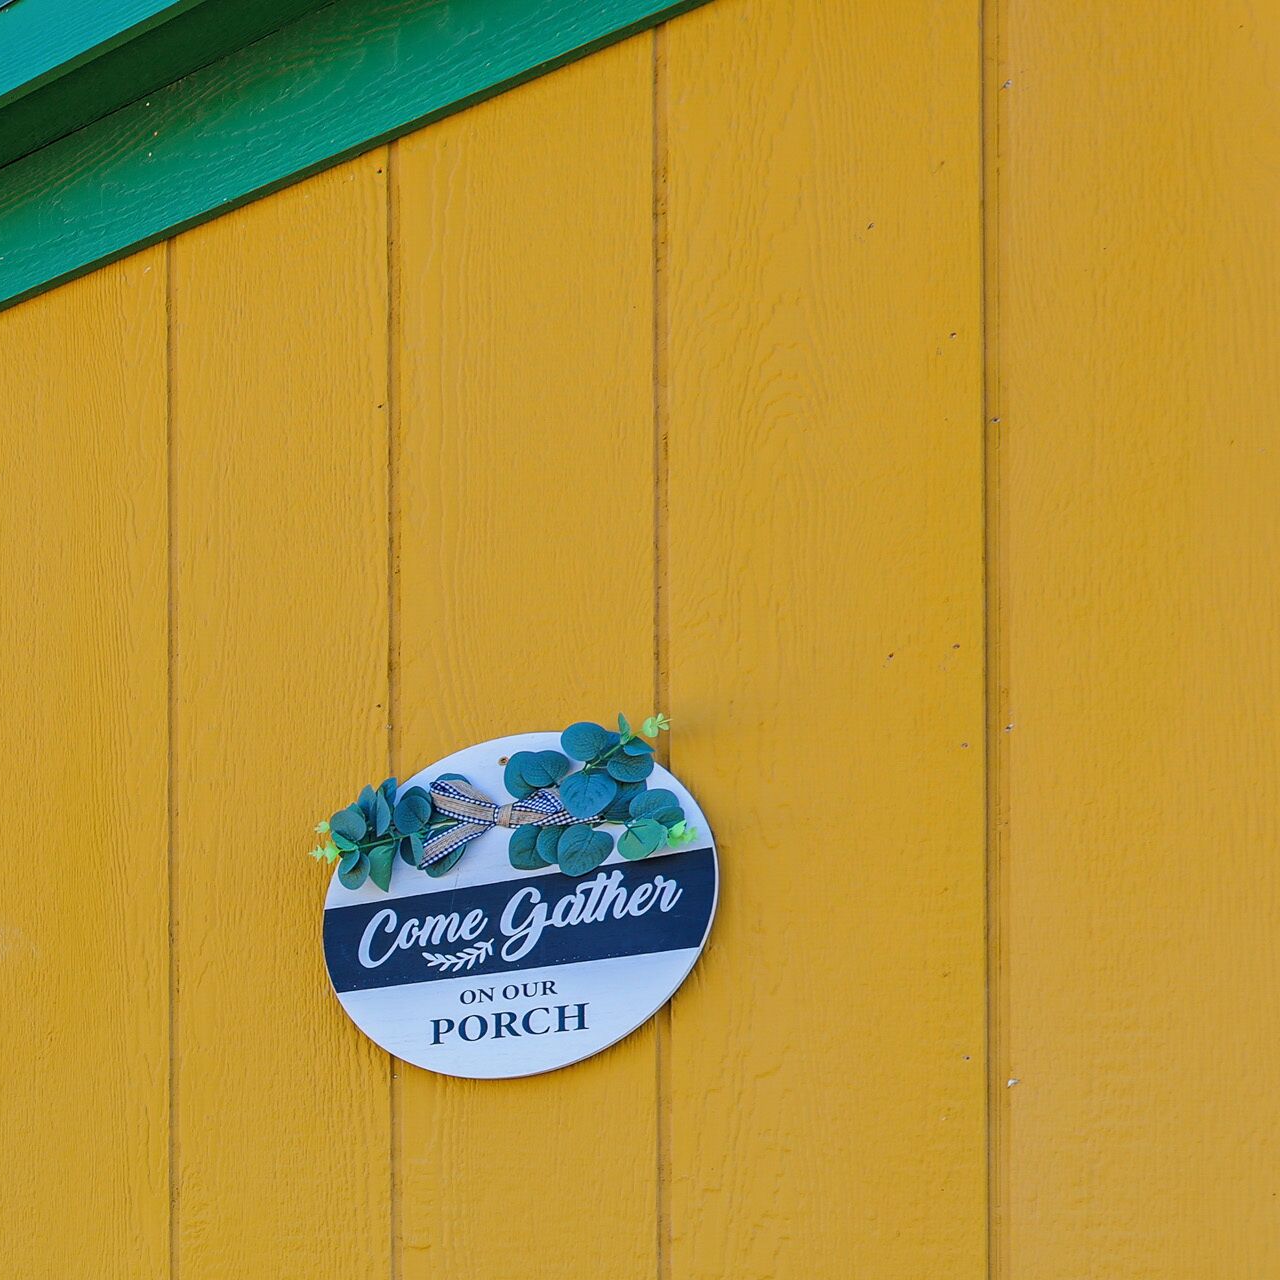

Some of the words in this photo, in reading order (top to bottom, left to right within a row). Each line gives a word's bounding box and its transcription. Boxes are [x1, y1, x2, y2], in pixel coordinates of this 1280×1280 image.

[357, 907, 488, 969] Come
[499, 869, 683, 963] Gather
[459, 986, 495, 1006] ON
[502, 980, 558, 999] OUR
[429, 1002, 591, 1047] PORCH
